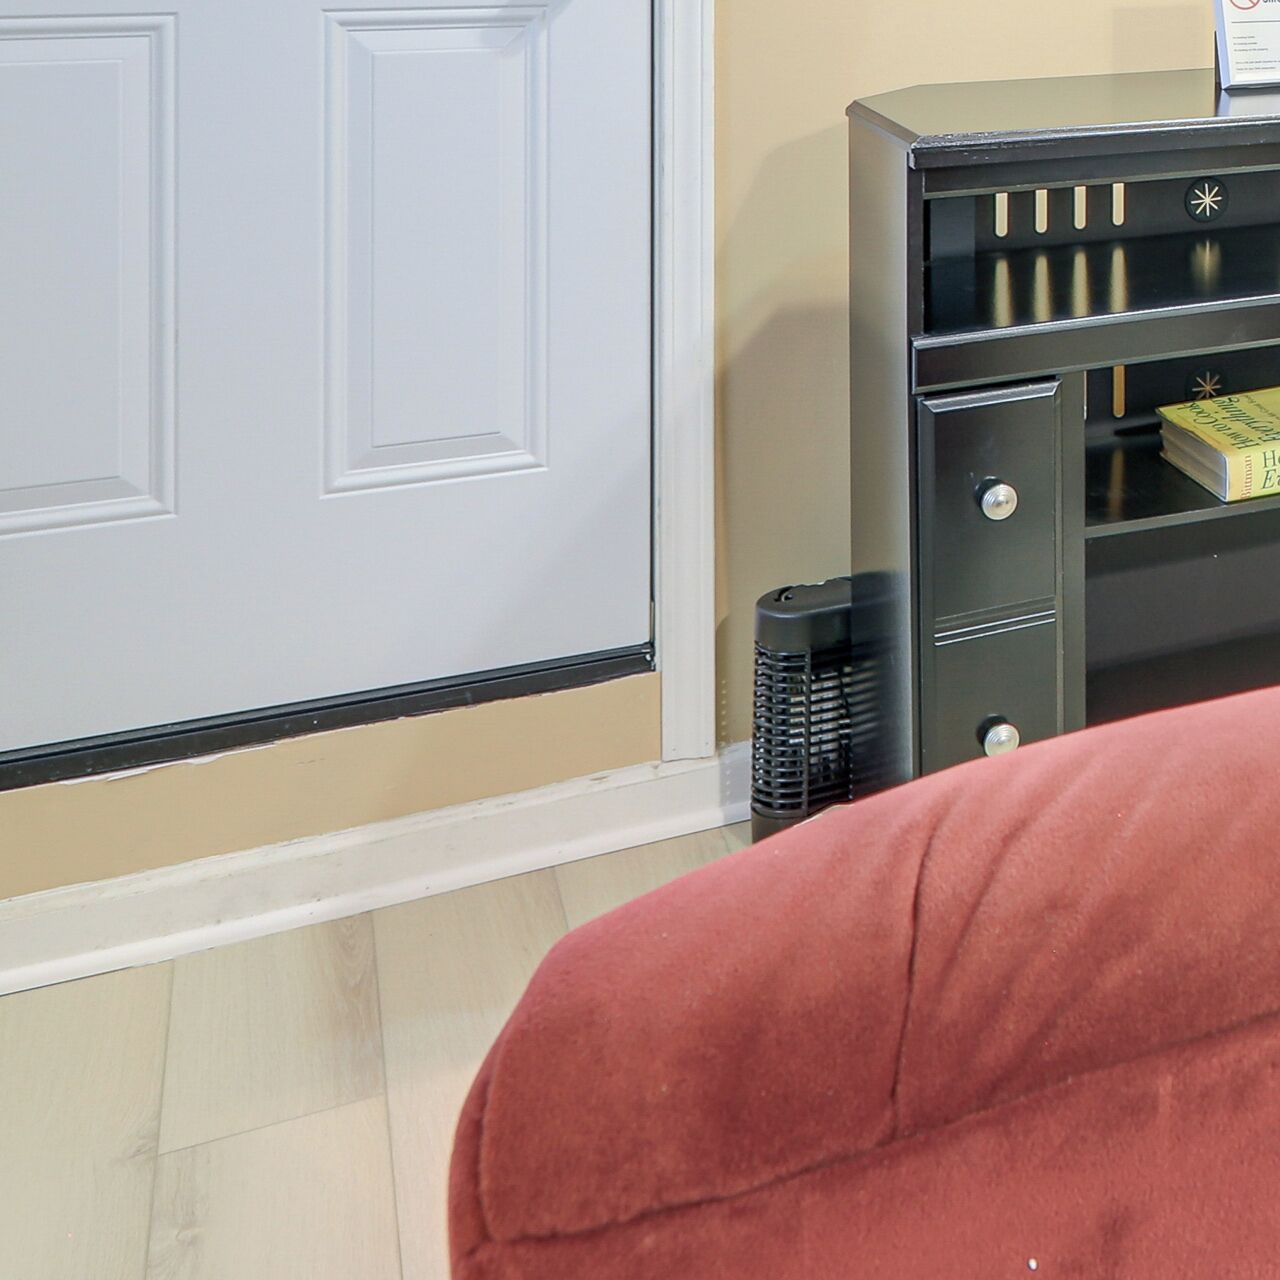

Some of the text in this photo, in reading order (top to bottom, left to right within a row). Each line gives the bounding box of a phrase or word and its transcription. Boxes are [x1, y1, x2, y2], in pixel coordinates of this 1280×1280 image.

[1177, 402, 1261, 449] How to Cook
[1241, 455, 1253, 499] Bittman
